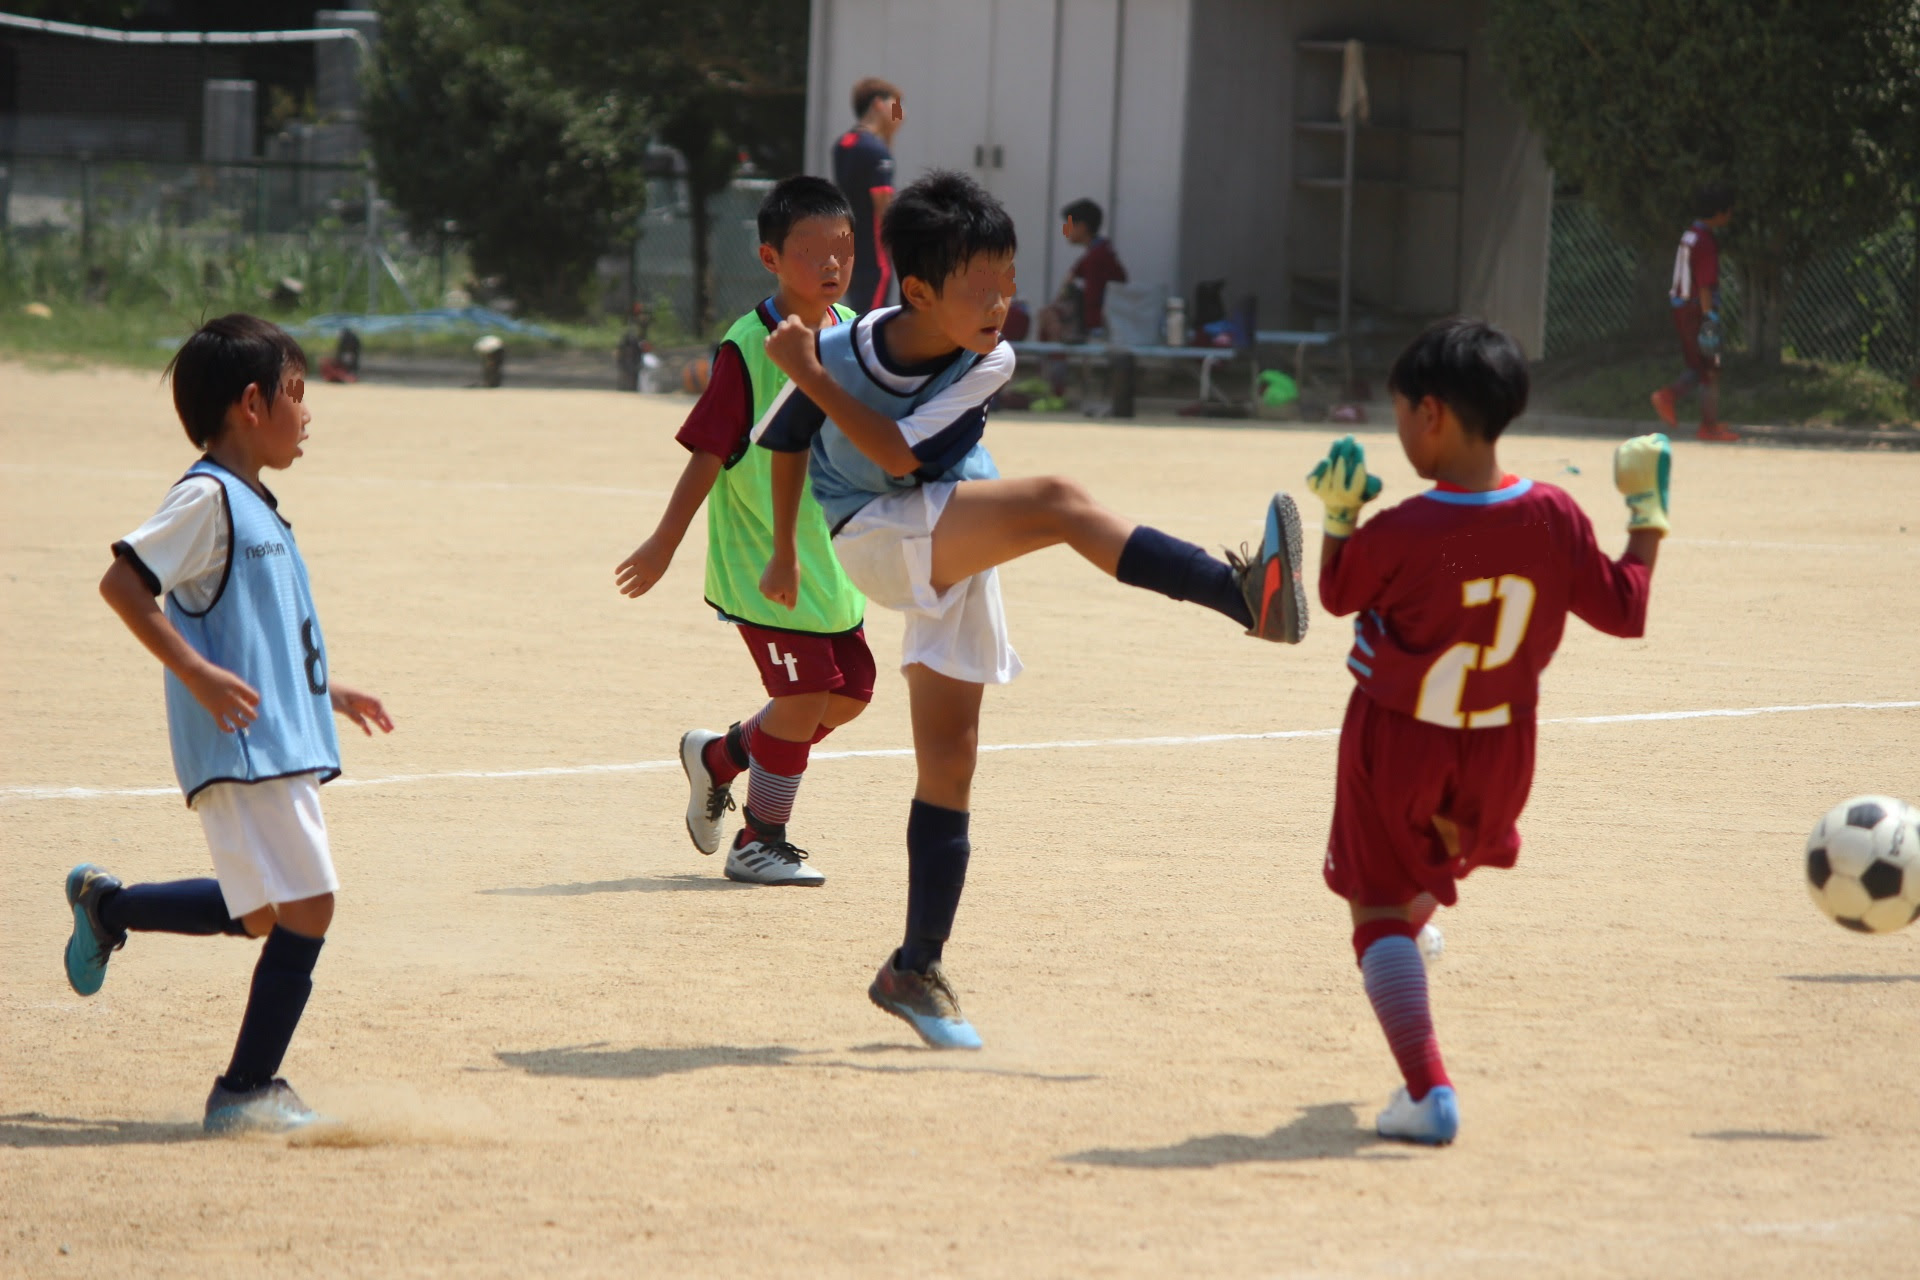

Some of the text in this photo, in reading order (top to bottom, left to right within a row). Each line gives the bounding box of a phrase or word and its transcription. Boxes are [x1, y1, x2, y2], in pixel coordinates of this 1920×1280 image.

[301, 616, 327, 696] 8
[767, 642, 799, 682] 4
[1414, 574, 1537, 729] 2
